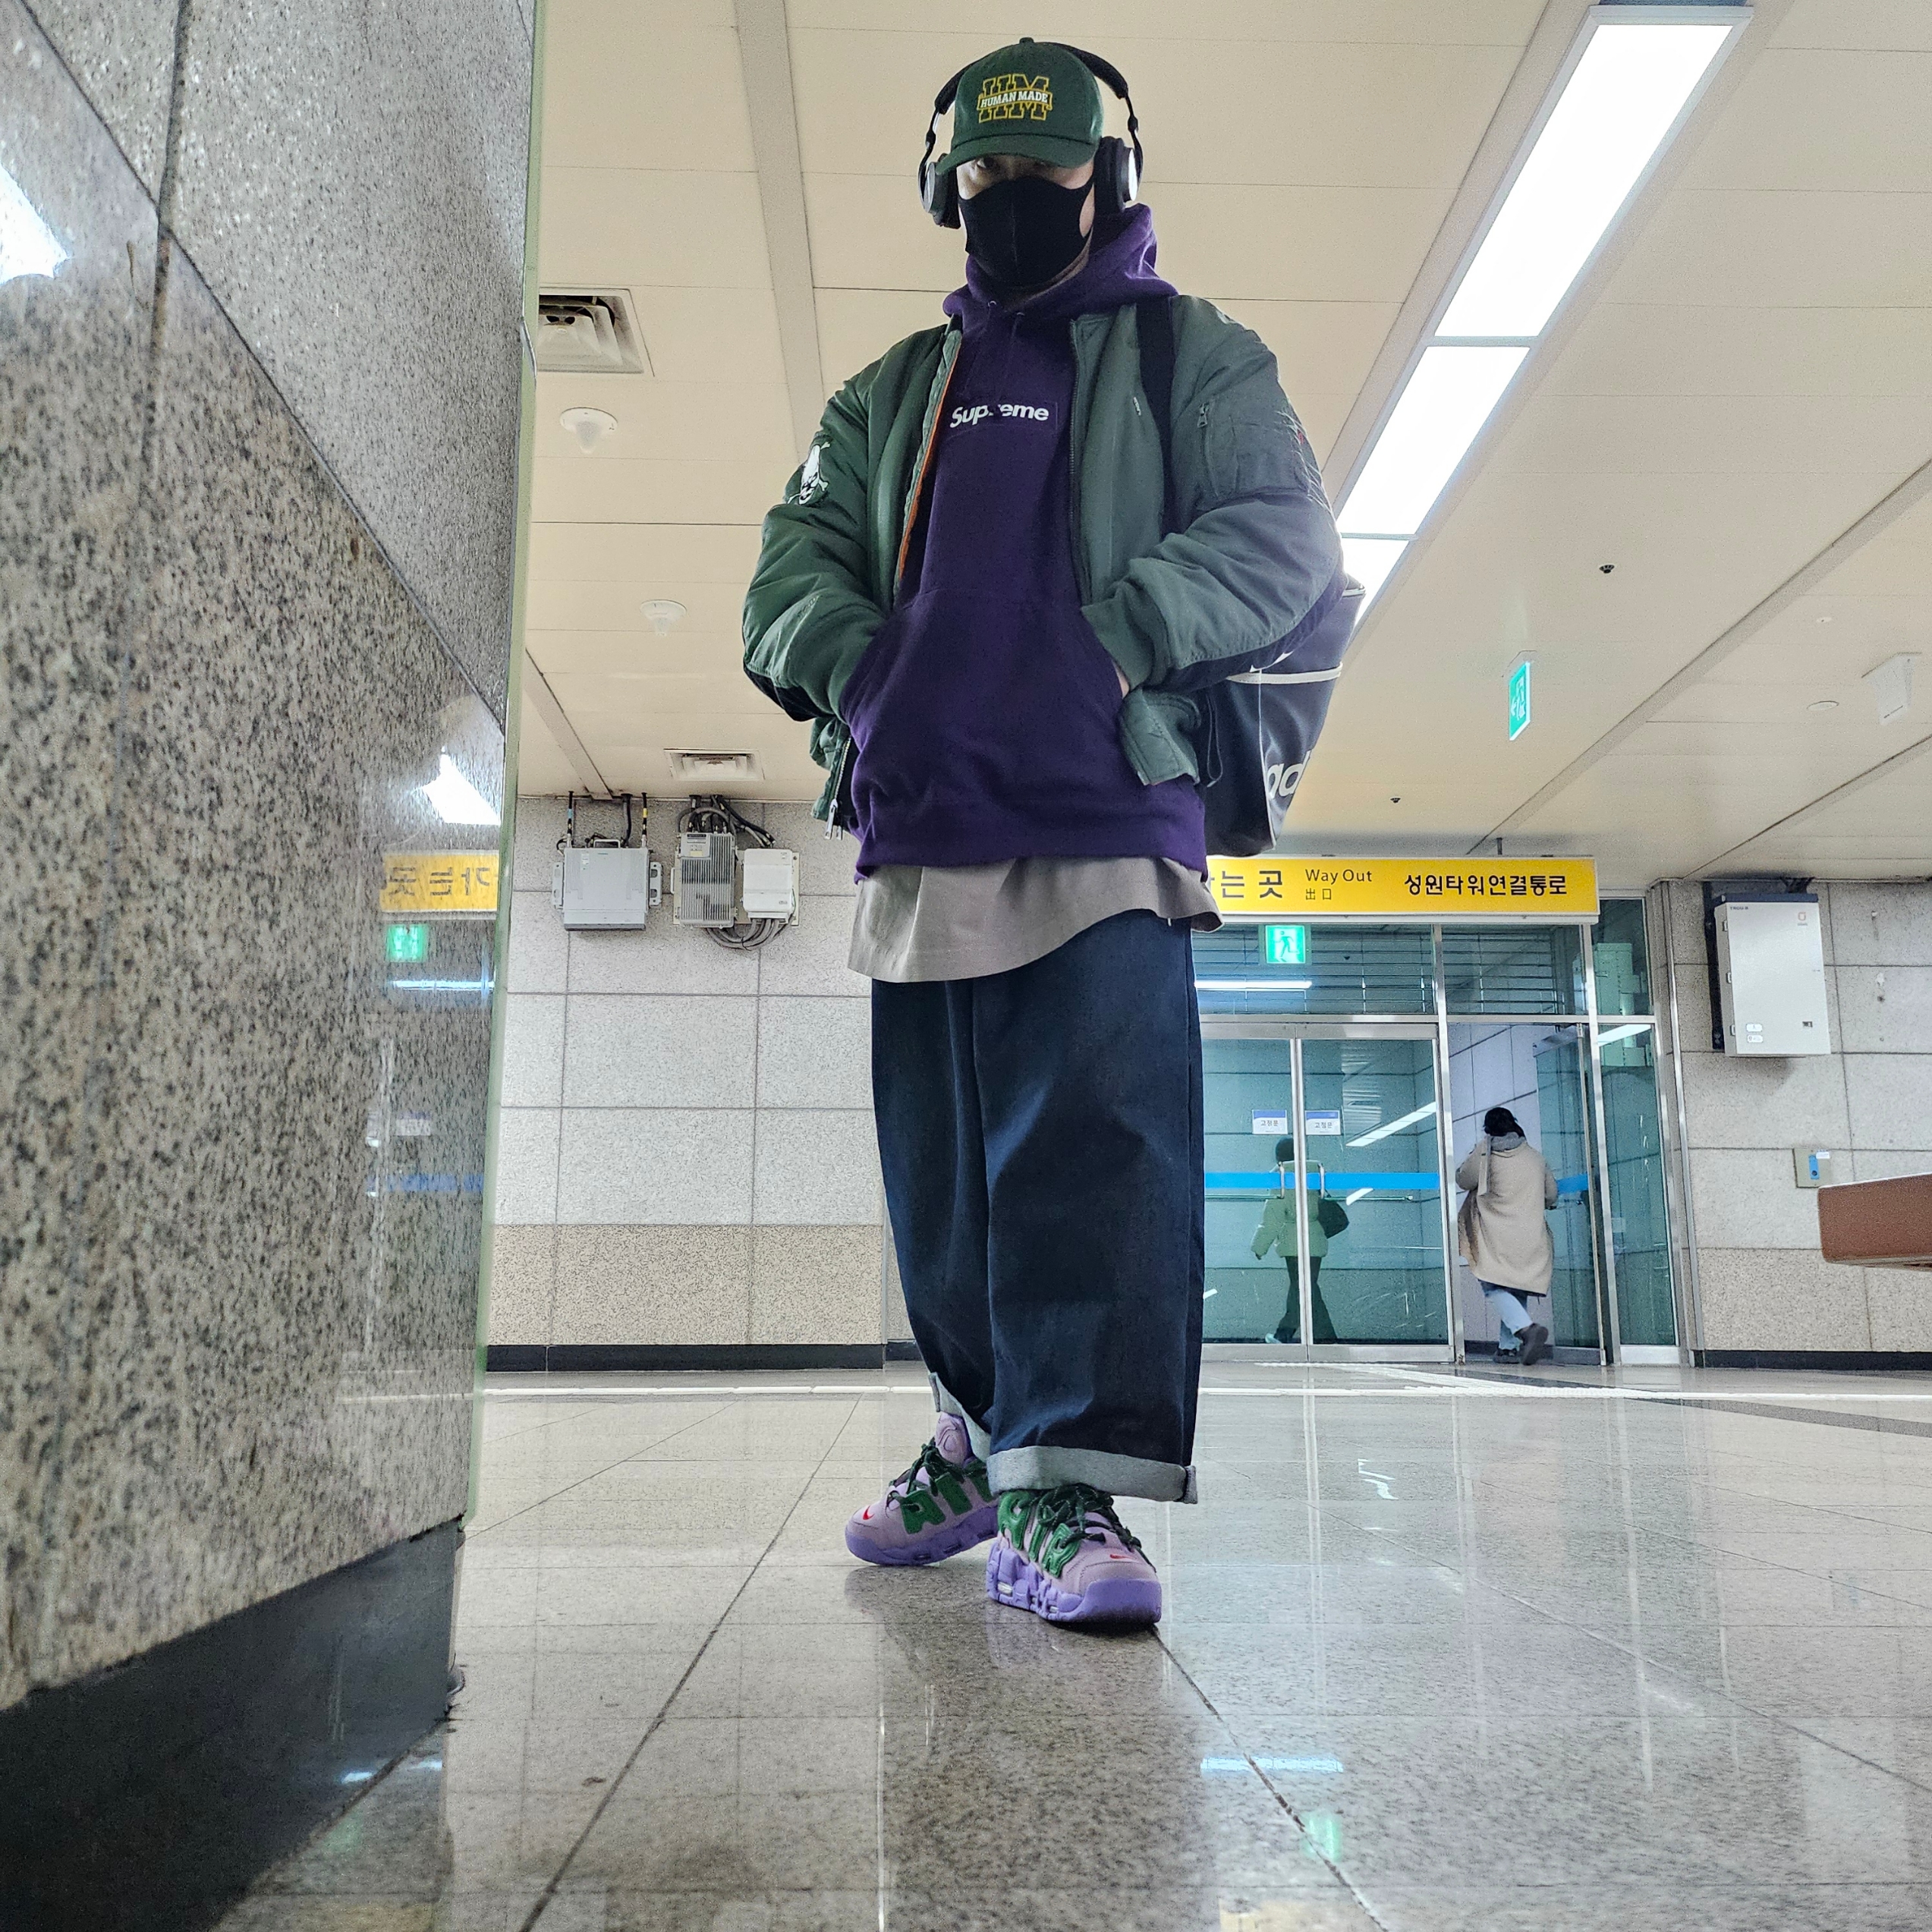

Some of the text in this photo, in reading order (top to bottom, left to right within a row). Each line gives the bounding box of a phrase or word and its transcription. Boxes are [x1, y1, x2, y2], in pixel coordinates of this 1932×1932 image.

[980, 90, 1049, 108] HUMAN MADE
[949, 403, 1049, 429] Supeme
[1209, 870, 1282, 898] 는 곳
[1305, 869, 1372, 885] Way Out
[1305, 888, 1332, 901] 出口
